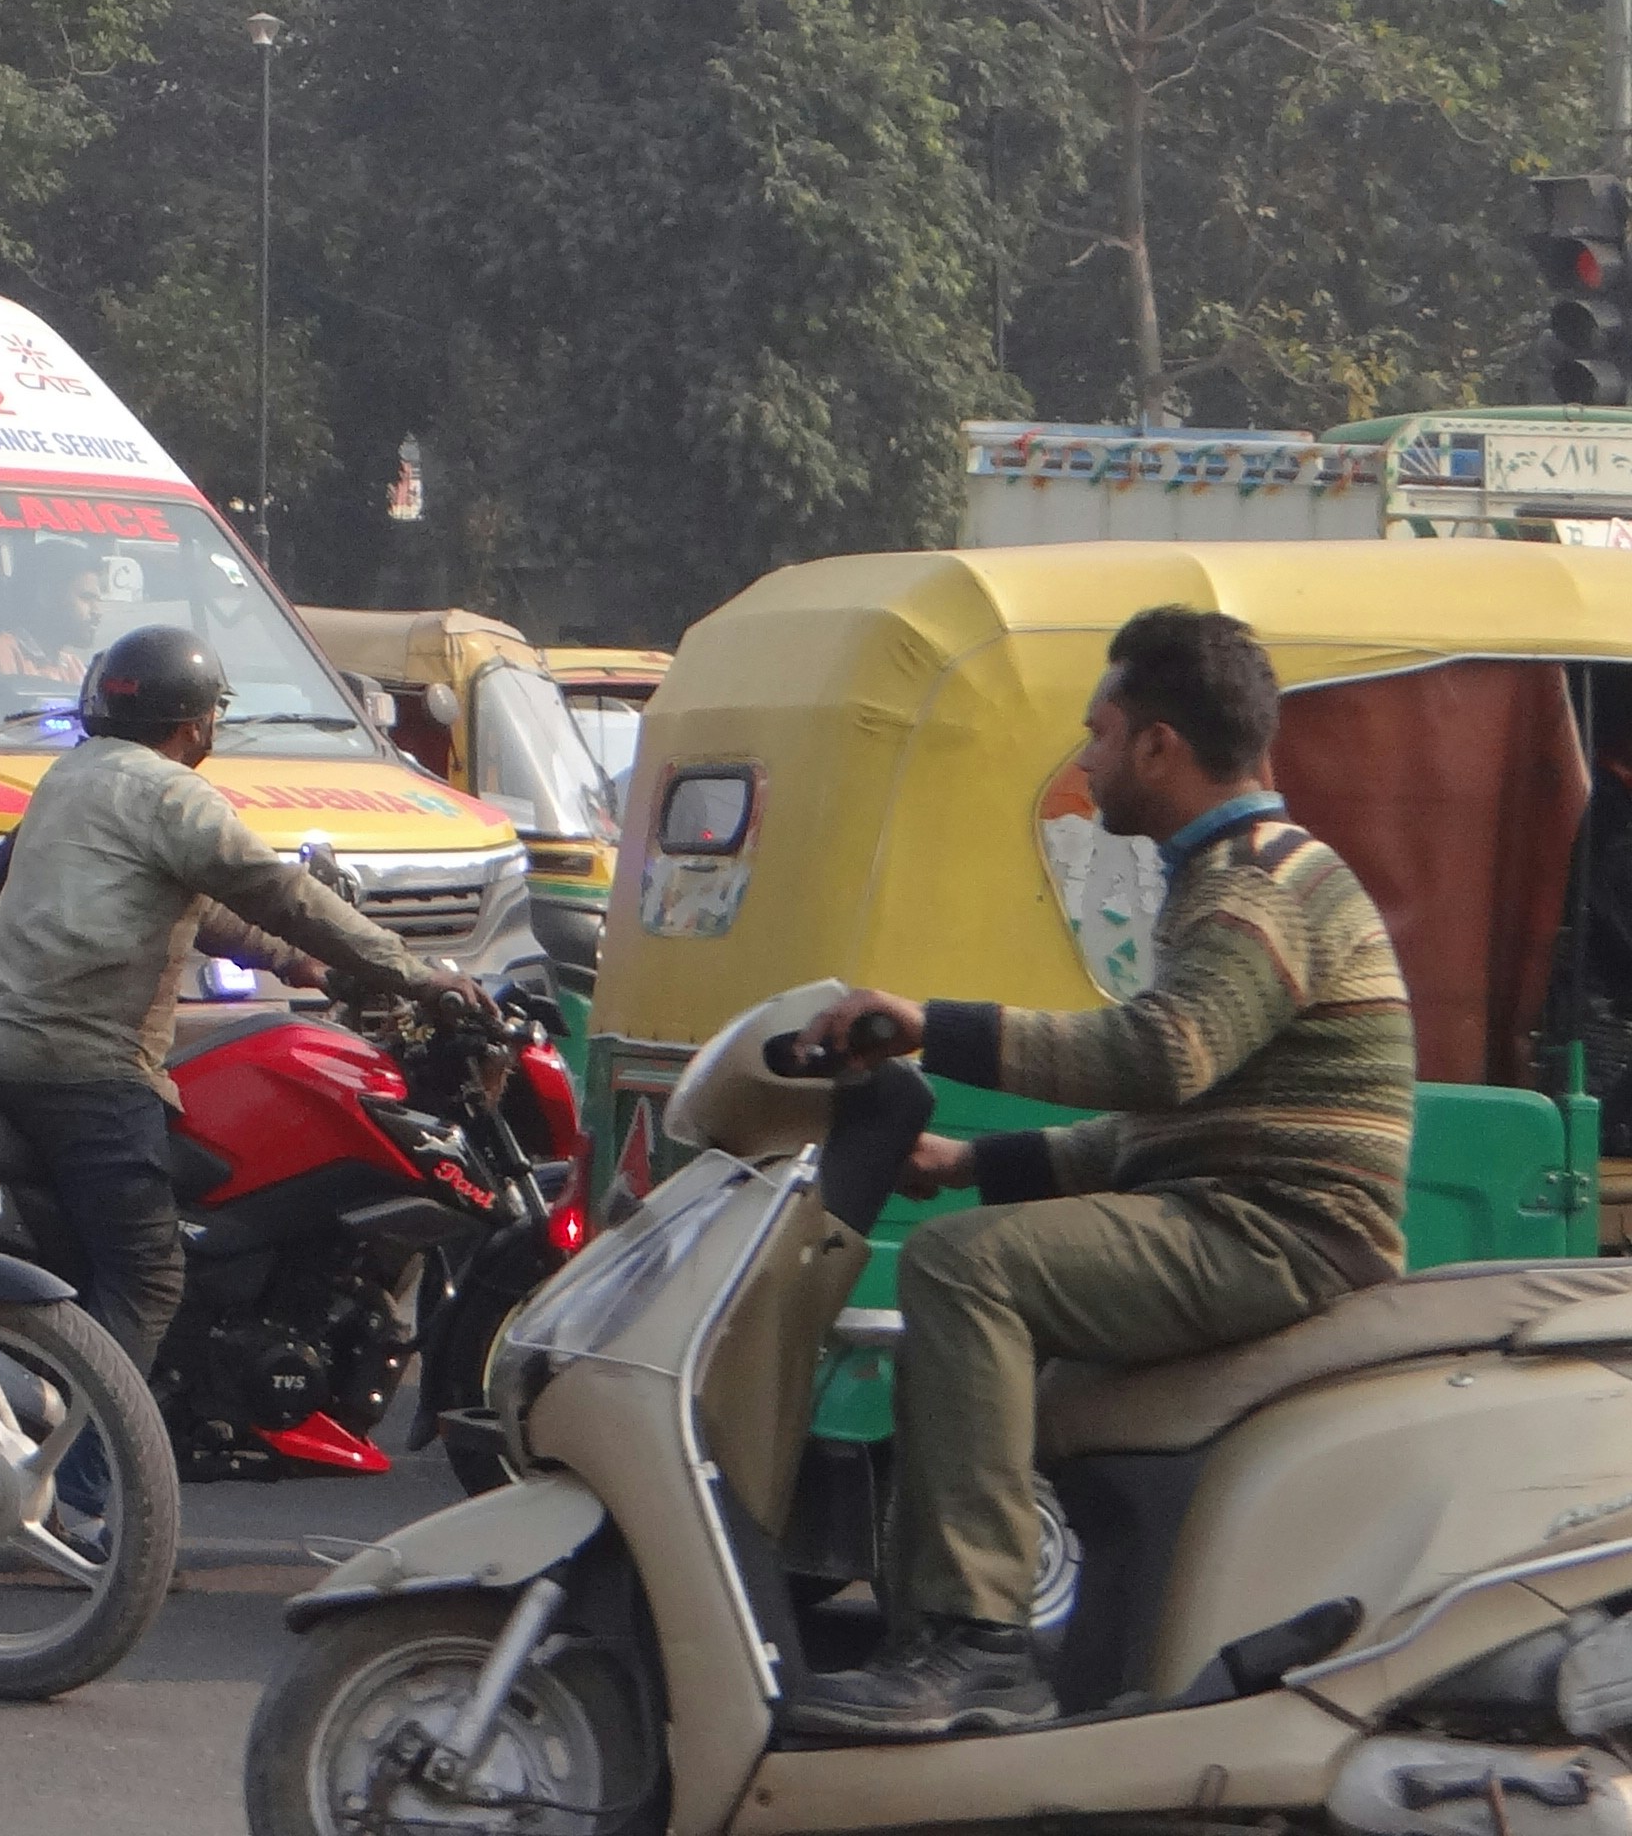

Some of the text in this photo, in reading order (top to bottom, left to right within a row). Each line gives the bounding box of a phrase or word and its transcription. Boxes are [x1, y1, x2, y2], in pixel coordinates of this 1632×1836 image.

[14, 372, 92, 397] CATS
[57, 431, 149, 465] SERVICE
[272, 1375, 306, 1389] TVS
